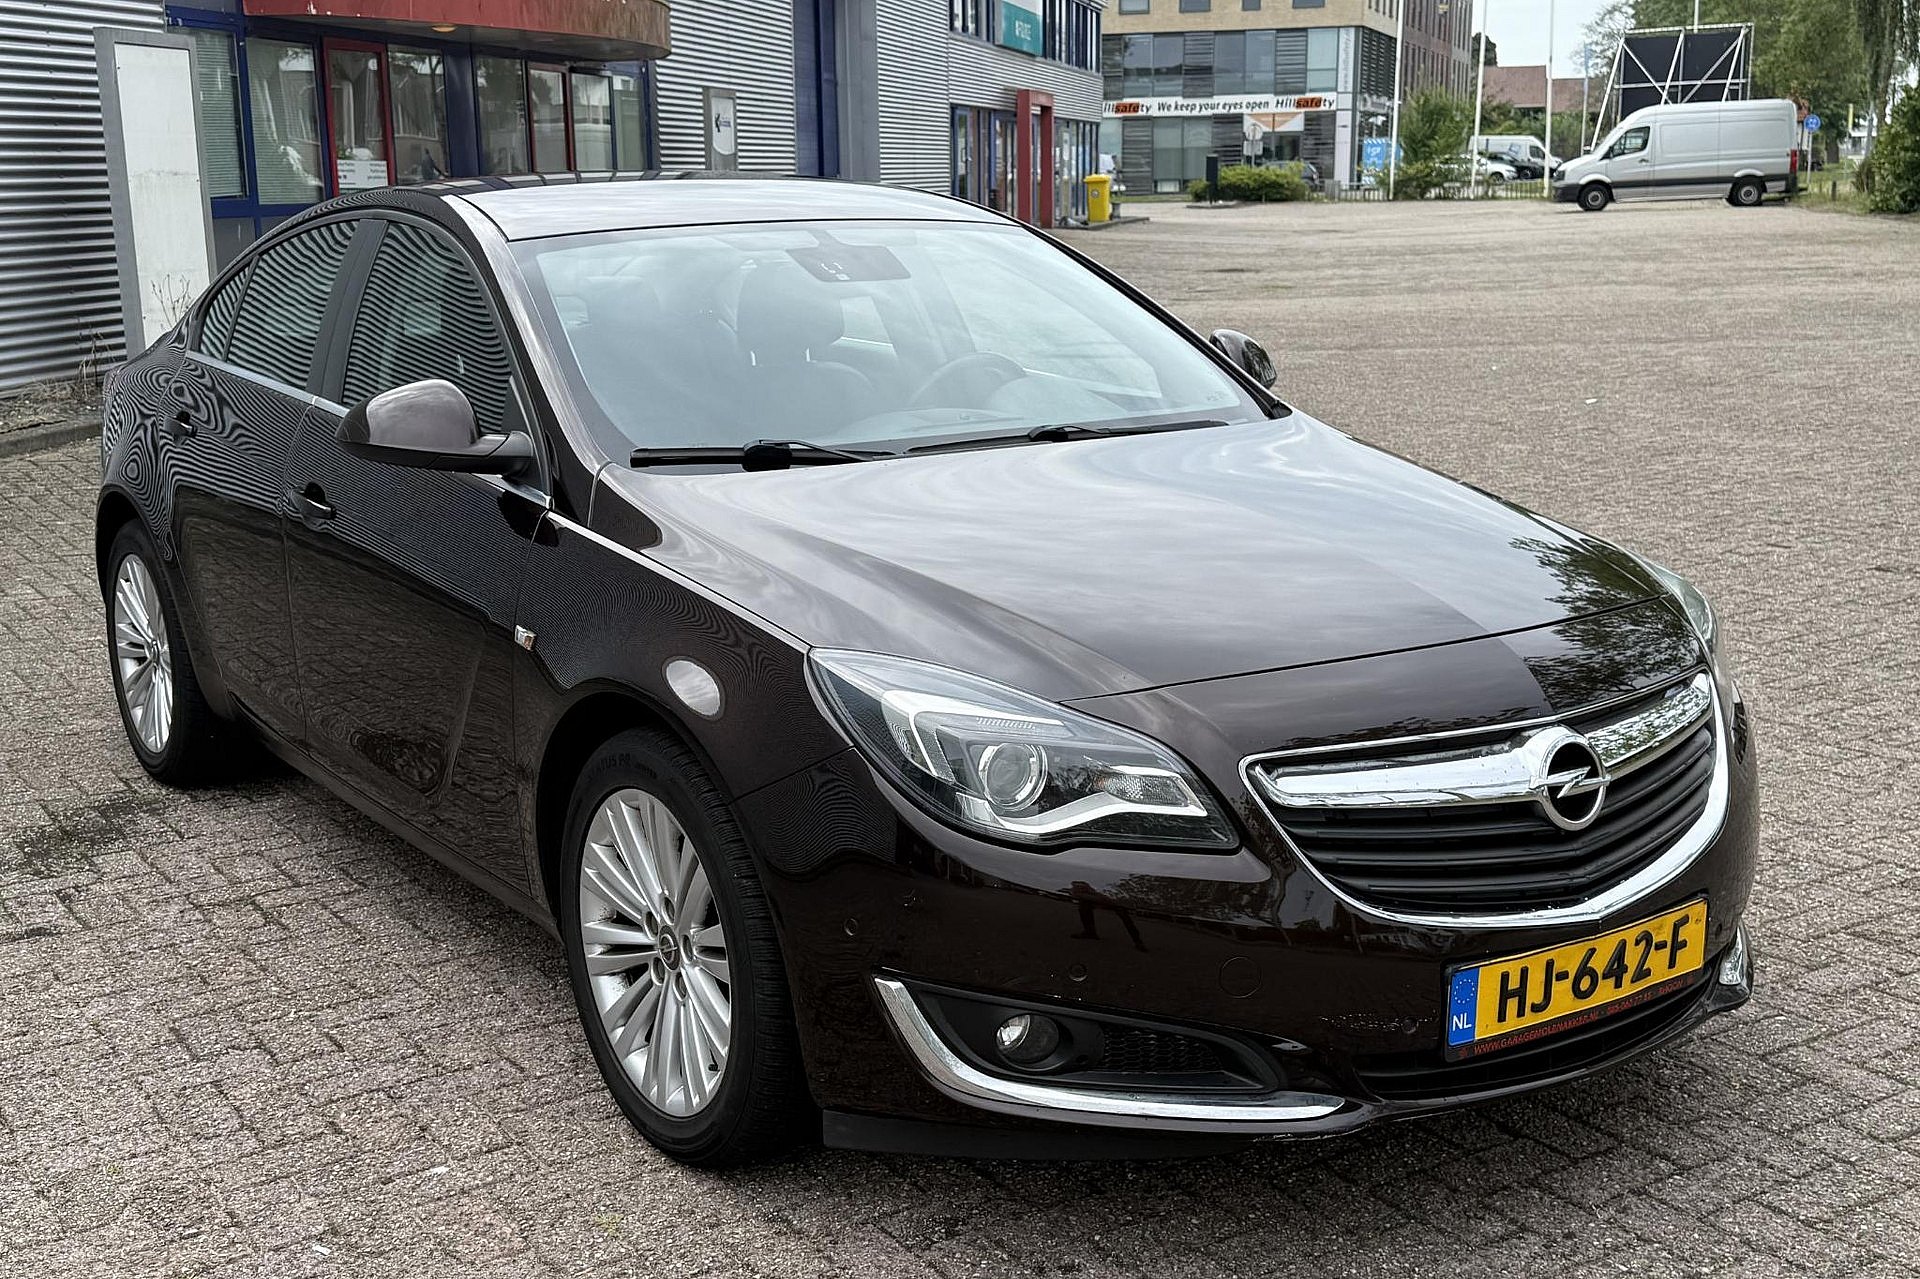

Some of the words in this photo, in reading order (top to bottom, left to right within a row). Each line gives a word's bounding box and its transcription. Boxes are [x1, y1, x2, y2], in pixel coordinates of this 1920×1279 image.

[1103, 102, 1151, 114] illsafety
[1157, 102, 1172, 112] We
[1174, 101, 1197, 113] keep
[1198, 102, 1220, 113] your
[1222, 102, 1243, 112] eyes
[1245, 100, 1270, 111] open
[1497, 914, 1690, 1023] HJ-642-F
[1452, 1012, 1472, 1032] NL
